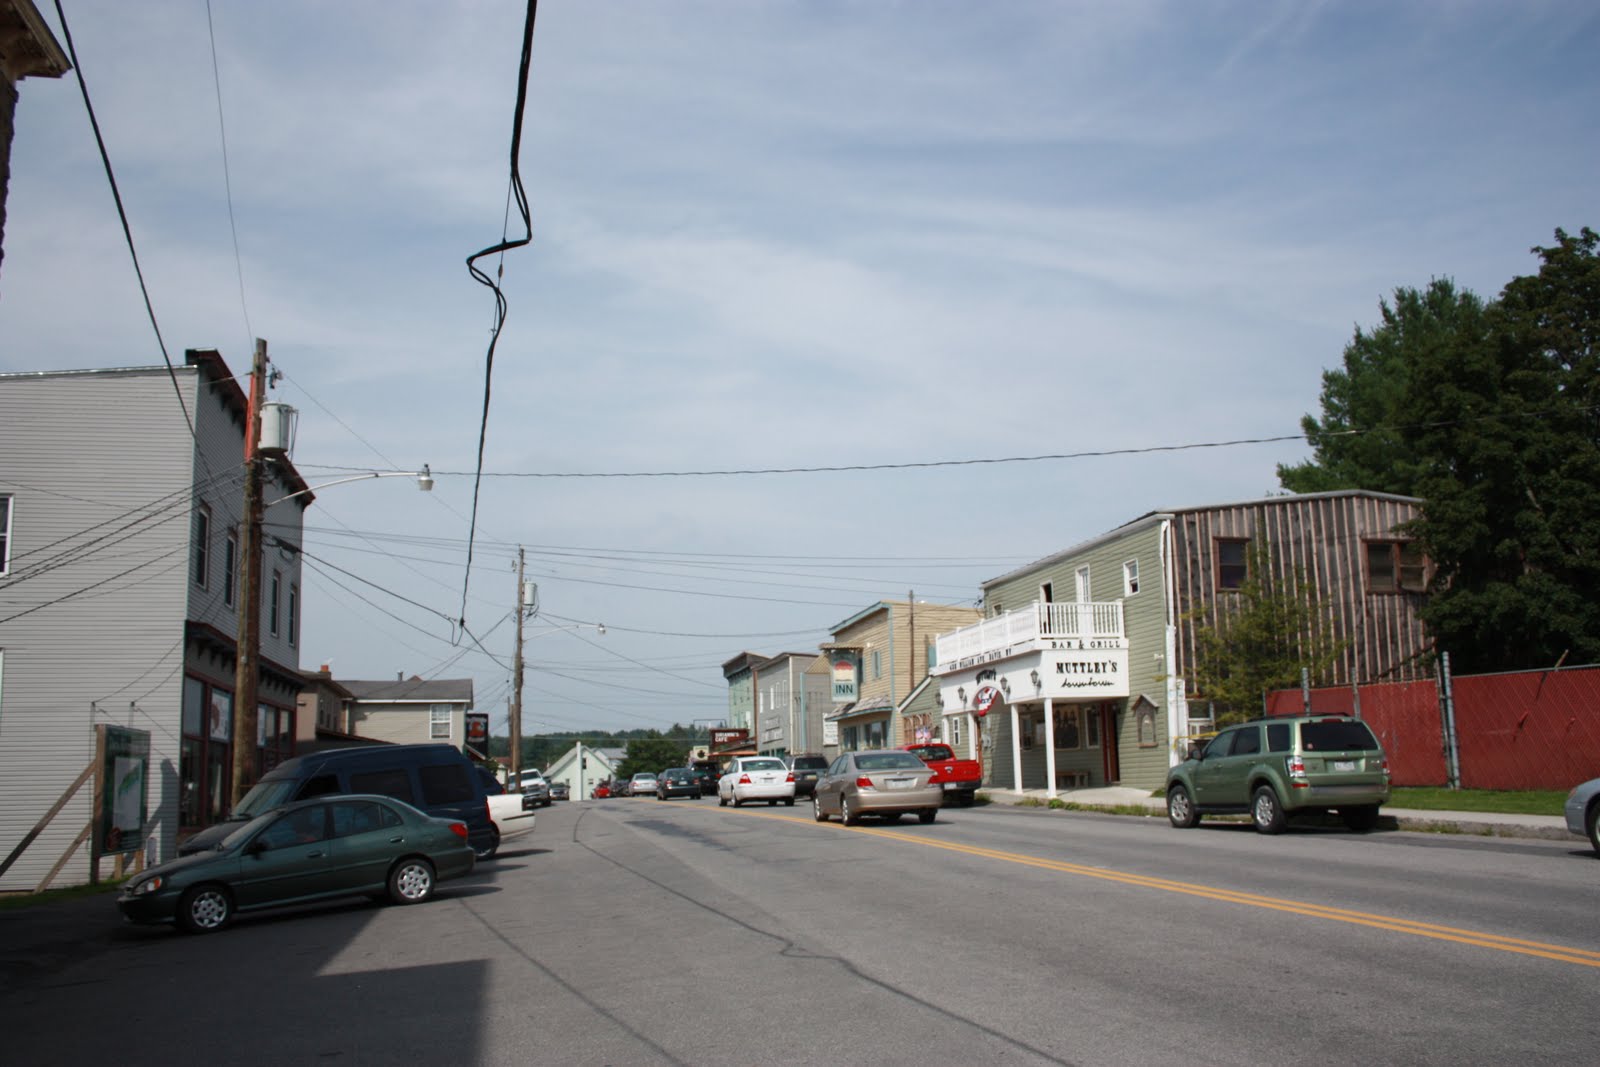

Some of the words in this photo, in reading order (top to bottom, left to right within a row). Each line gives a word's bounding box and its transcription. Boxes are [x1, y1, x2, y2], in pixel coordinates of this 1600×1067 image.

[1051, 641, 1072, 649] BAR
[1078, 639, 1084, 650] &
[1090, 640, 1120, 648] GRILL
[1056, 660, 1118, 674] MUTTLEY'S
[835, 684, 853, 694] INN
